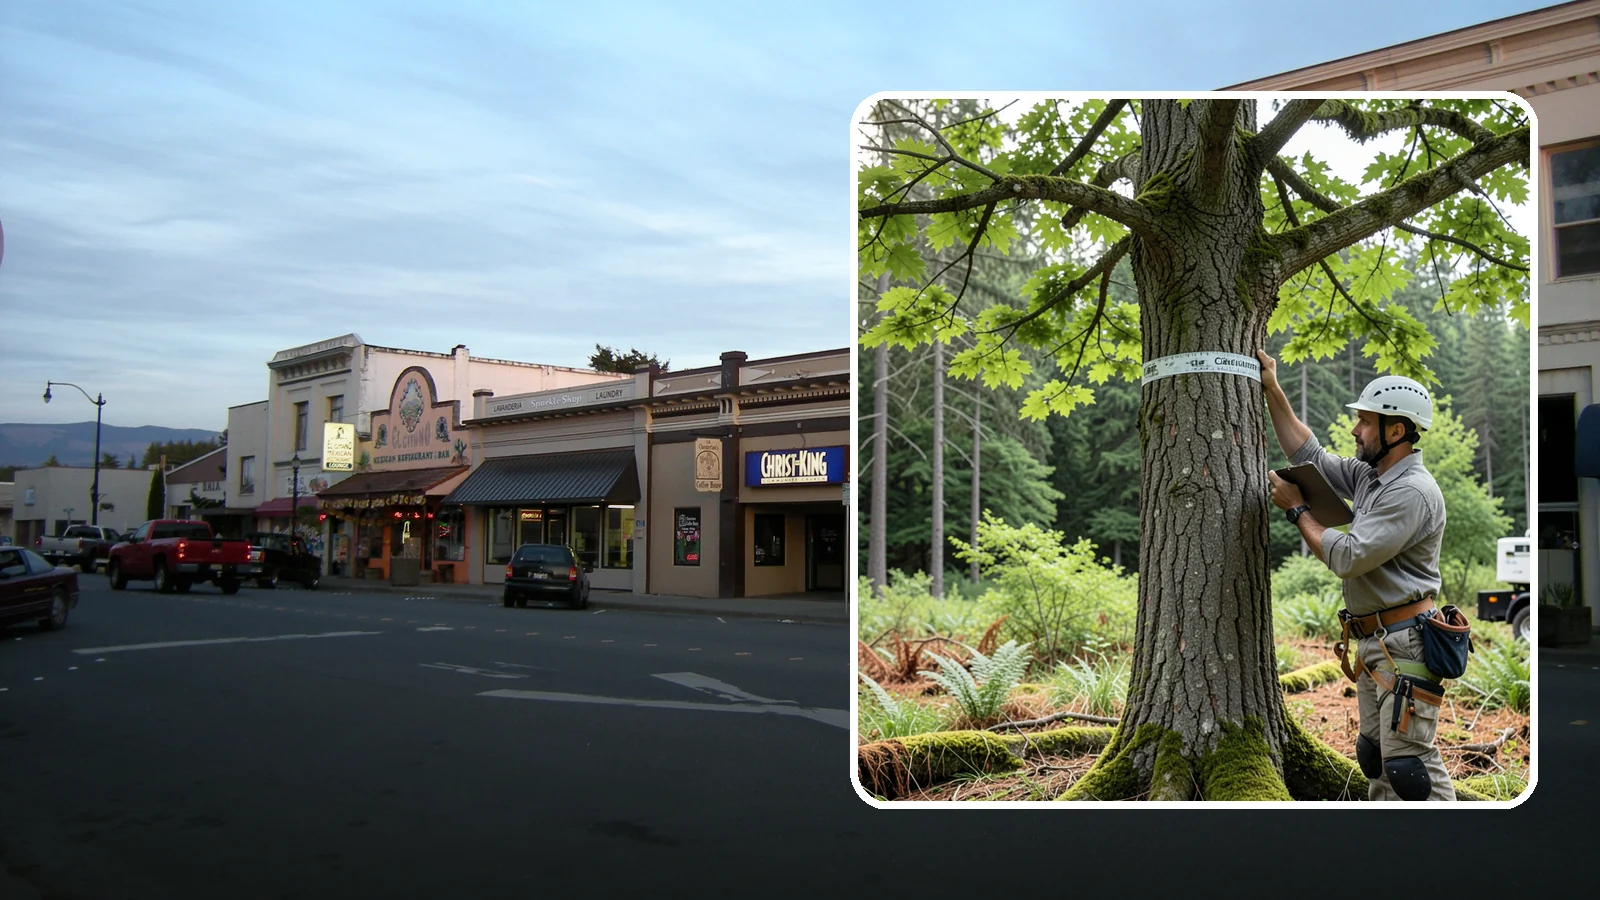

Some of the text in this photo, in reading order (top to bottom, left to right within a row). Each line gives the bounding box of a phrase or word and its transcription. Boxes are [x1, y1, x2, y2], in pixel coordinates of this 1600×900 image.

[493, 389, 623, 413] LAVANDERIA Sparkle Shop LAUNDRY
[373, 455, 396, 464] MEXICAN
[397, 451, 434, 462] RESTAURANT
[437, 450, 450, 459] BAR
